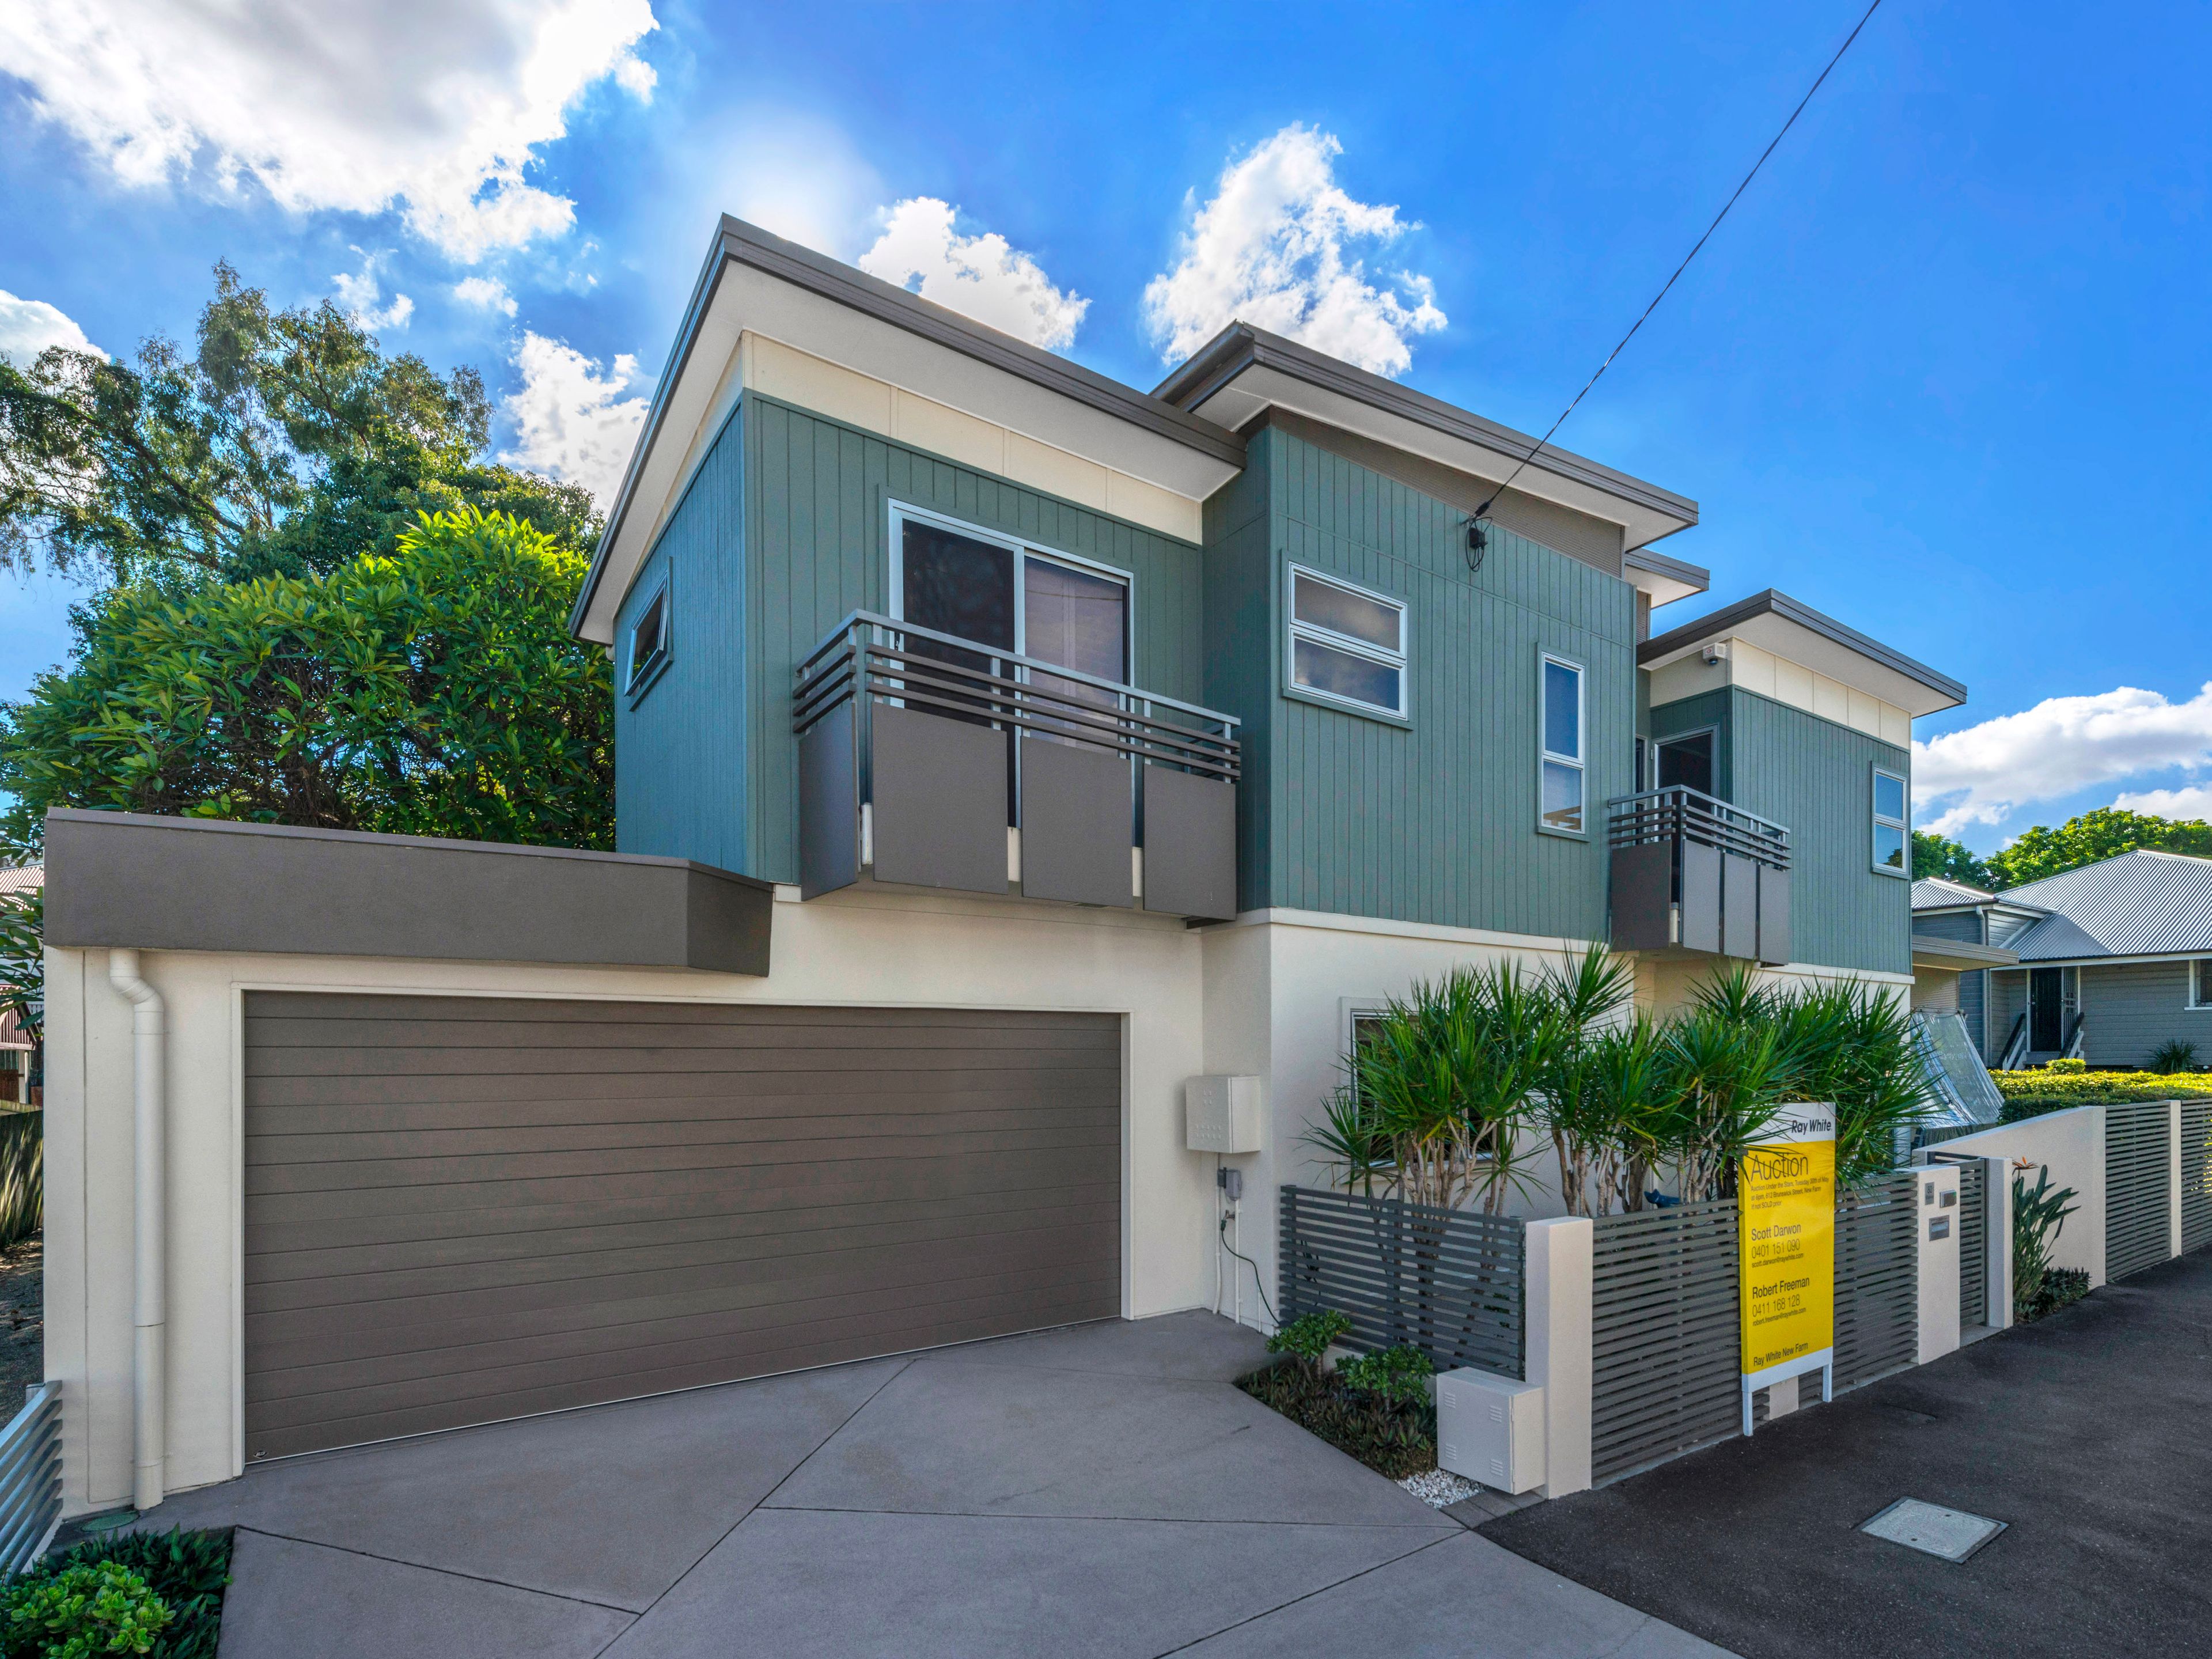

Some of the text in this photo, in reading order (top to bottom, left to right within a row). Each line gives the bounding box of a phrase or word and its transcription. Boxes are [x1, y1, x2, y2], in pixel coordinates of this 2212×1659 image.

[1791, 1119, 1831, 1135] Ray White
[1751, 1153, 1809, 1181] Auction
[1752, 1224, 1801, 1241] Scott Darwon
[1752, 1238, 1800, 1259] 0401 151 090
[1752, 1277, 1810, 1299] Robert Freeman
[1752, 1294, 1800, 1317] 0411 168 128
[1753, 1343, 1808, 1367] Ray White New Farm
